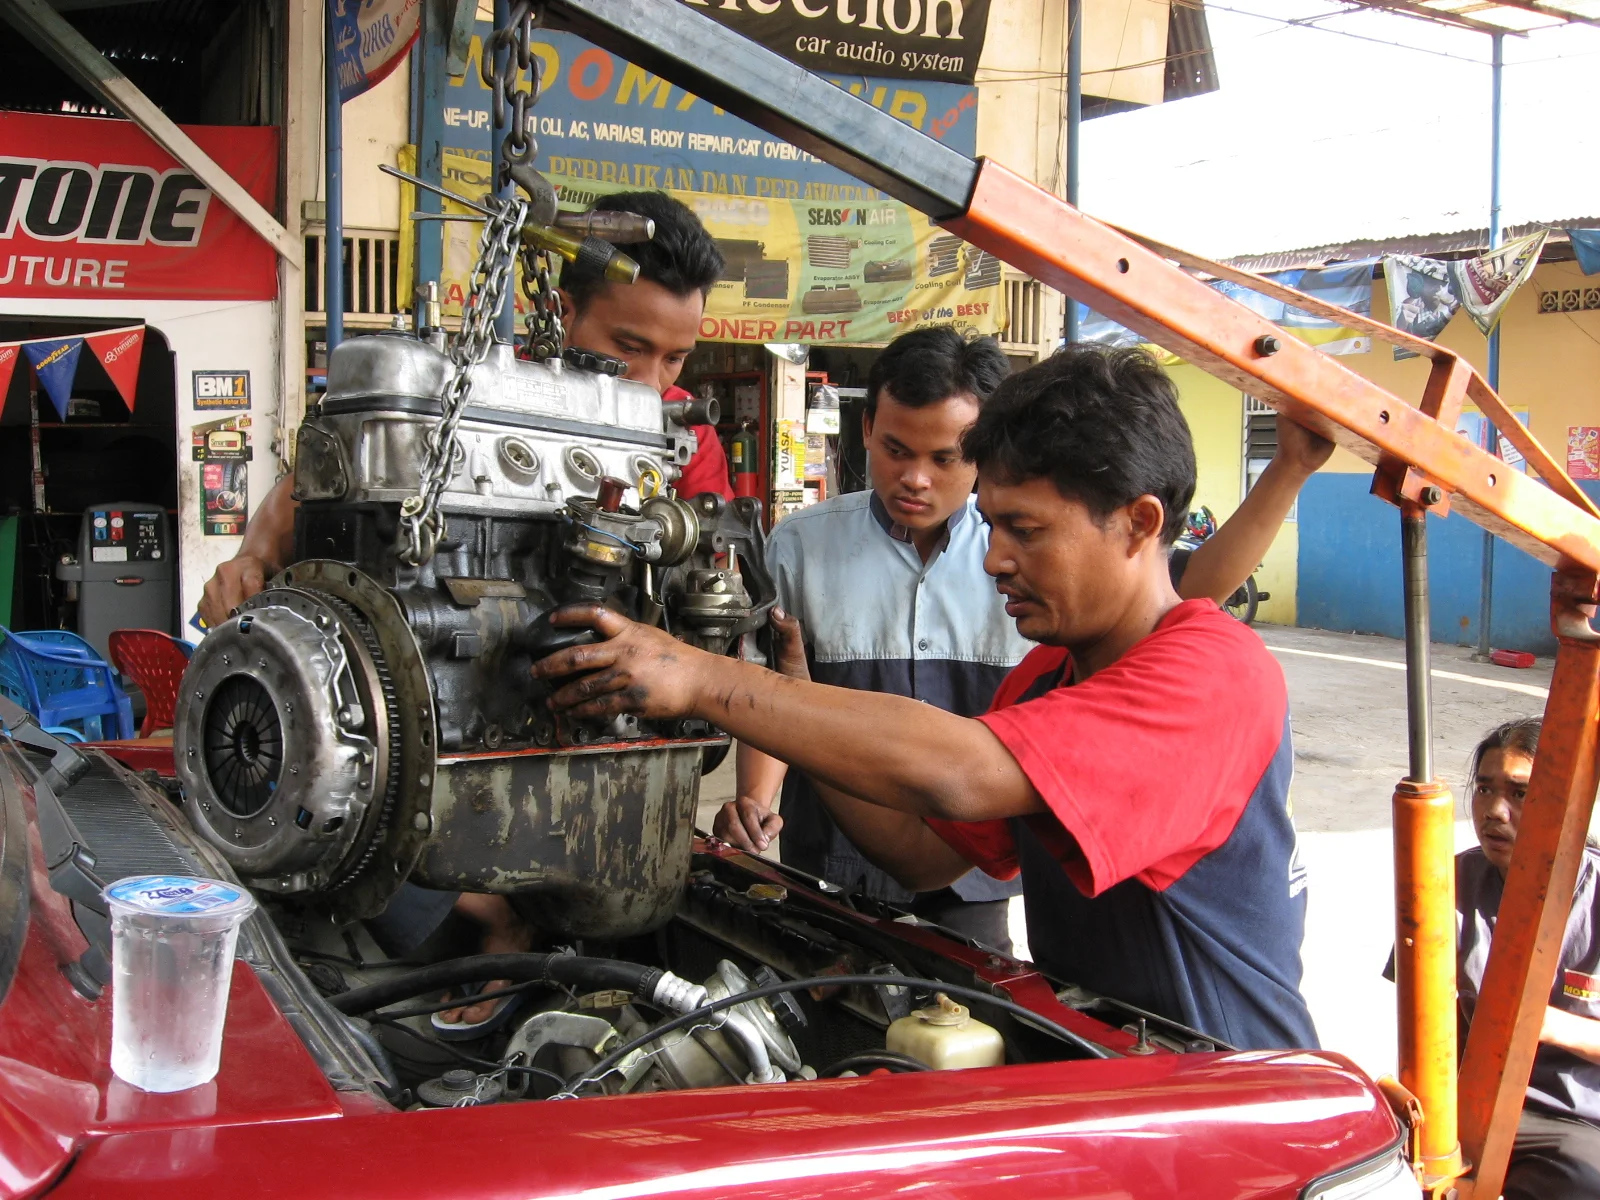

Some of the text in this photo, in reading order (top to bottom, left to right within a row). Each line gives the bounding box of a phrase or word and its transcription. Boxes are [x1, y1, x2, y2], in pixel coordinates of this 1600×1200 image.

[795, 35, 964, 72] car audio system
[443, 107, 490, 131] NE-UP,
[568, 120, 590, 141] AC,
[593, 122, 647, 147] VARIASI,
[650, 128, 685, 149] BODY
[702, 170, 748, 195] DAN
[869, 208, 896, 225] AIR
[915, 282, 944, 290] Cooling
[753, 301, 790, 309] Condenser
[887, 302, 990, 323] BEST of the BEST
[698, 317, 853, 340] ONER PART
[781, 431, 790, 473] YUASA
